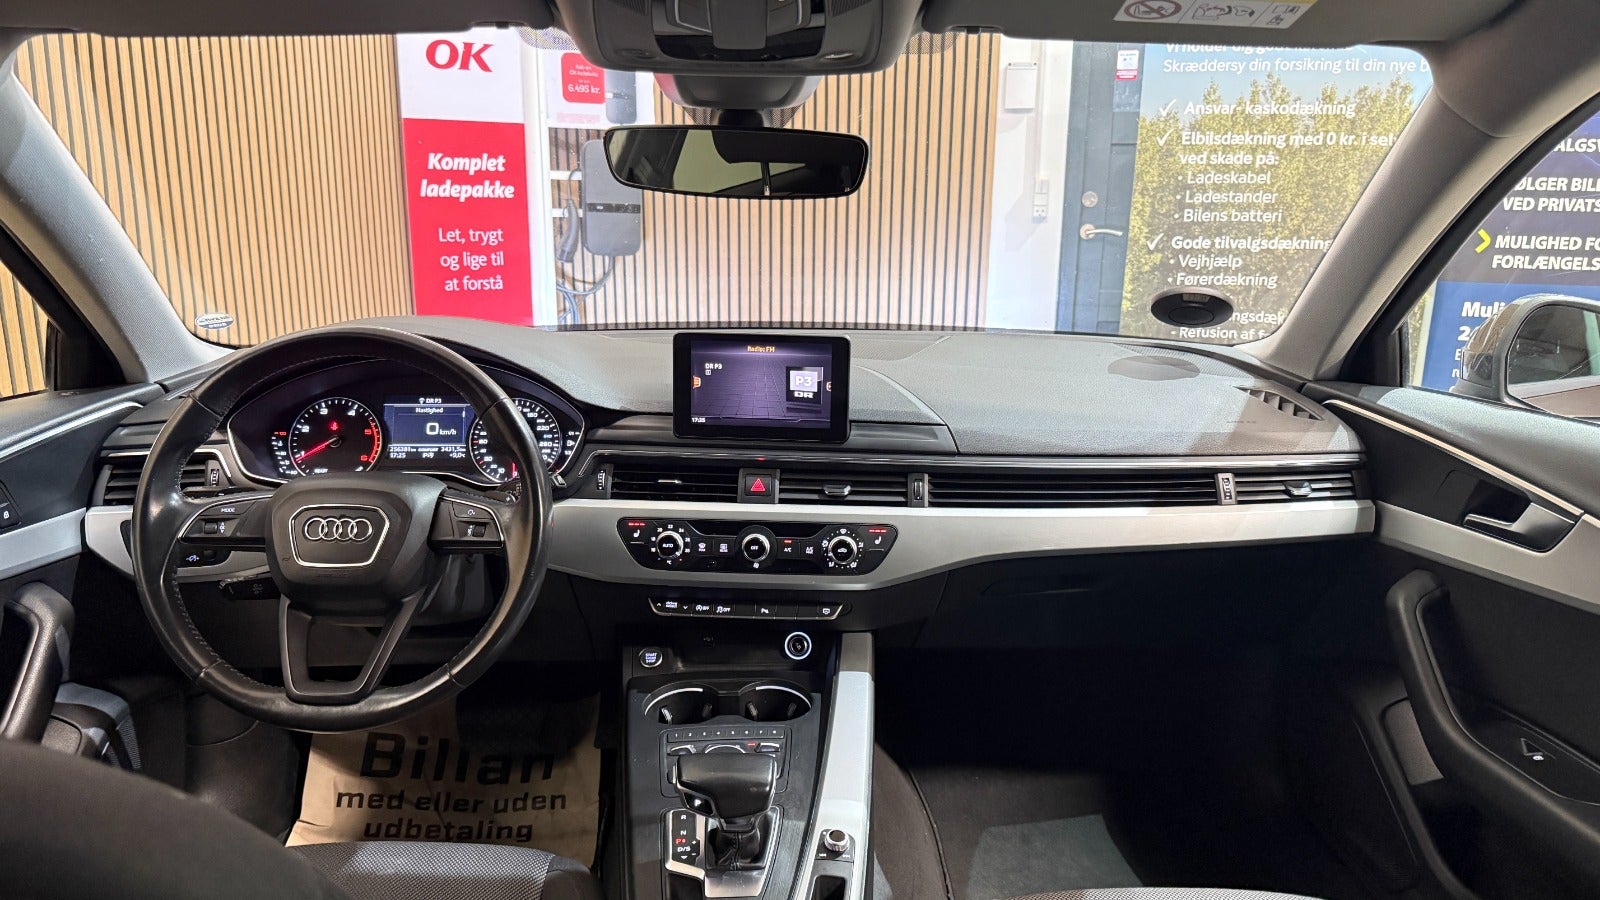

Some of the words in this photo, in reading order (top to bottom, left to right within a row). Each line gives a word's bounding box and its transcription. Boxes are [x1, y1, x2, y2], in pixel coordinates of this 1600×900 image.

[426, 40, 494, 73] OK
[1163, 59, 1245, 74] Skræddersy
[1249, 59, 1271, 71] din
[1274, 58, 1341, 73] forsikring
[1345, 59, 1360, 71] til
[1363, 59, 1385, 71] din
[1389, 61, 1417, 74] nye
[568, 84, 590, 92] 6.495
[1245, 101, 1356, 118] kaskodækning
[1181, 131, 1287, 149] Elbilsdækning
[1289, 132, 1324, 146] med
[1326, 131, 1337, 146] 0
[1340, 132, 1359, 146] kr.
[1361, 132, 1368, 146] i
[427, 153, 505, 175] Komplet
[1179, 151, 1207, 165] ved
[1209, 151, 1253, 165] skade
[1255, 150, 1280, 168] på:
[1187, 170, 1272, 185] Ladeskabel
[420, 179, 515, 202] ladepakke
[1185, 189, 1278, 204] Ladestander
[1503, 196, 1535, 211] VED
[1183, 209, 1228, 223] Bilens
[1231, 208, 1283, 223] batteri
[438, 228, 466, 244] Let,
[469, 228, 504, 245] trygt
[1171, 237, 1211, 250] Gode
[1495, 234, 1582, 251] MULIGHED
[440, 256, 459, 270] og
[463, 252, 487, 269] lige
[490, 252, 505, 266] til
[1179, 254, 1242, 269] Vejhjælp
[444, 276, 459, 291] at
[462, 275, 504, 291] forstå
[1176, 272, 1277, 288] Førerdækning
[795, 375, 812, 387] P3
[426, 422, 440, 436] 0
[336, 790, 405, 809] med
[415, 791, 484, 813] eller
[494, 792, 567, 814] uden
[694, 799, 702, 807] P
[363, 818, 534, 843] udbetaling
